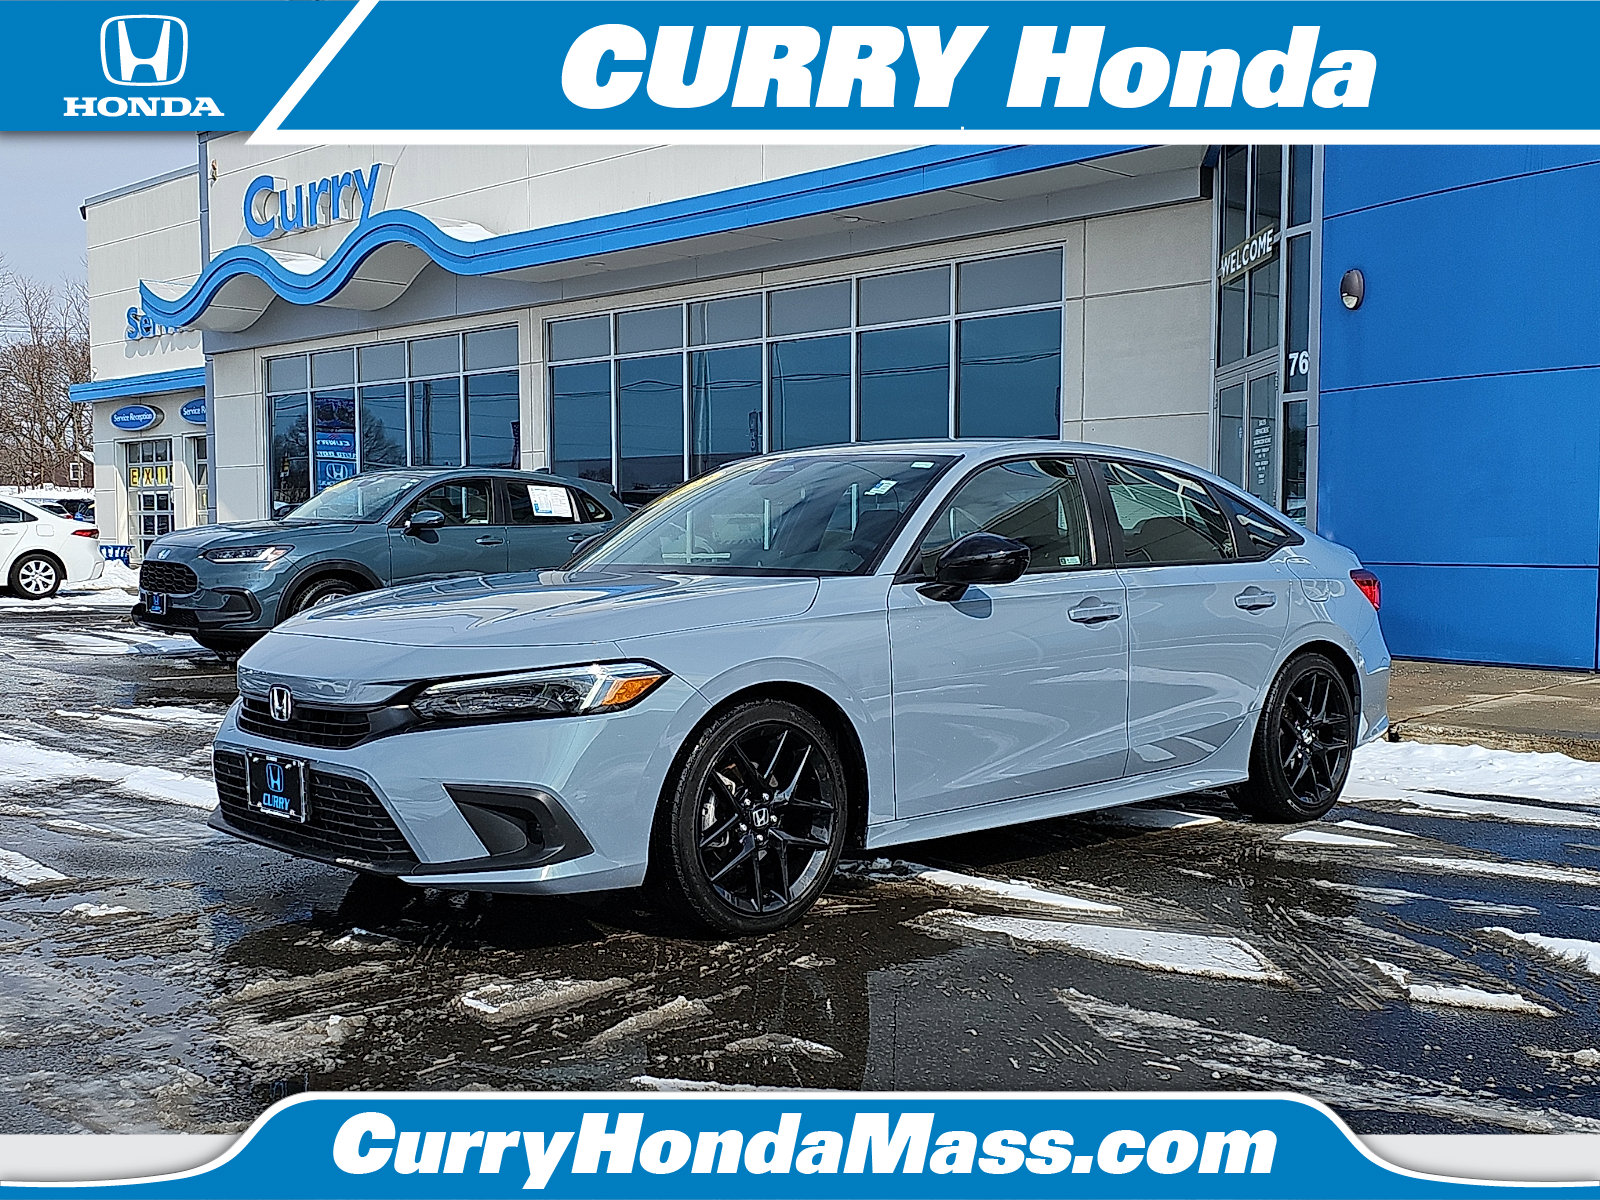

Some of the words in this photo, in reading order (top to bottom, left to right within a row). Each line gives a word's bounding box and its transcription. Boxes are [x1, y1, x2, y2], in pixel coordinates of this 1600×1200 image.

[243, 163, 381, 238] Curry
[1221, 229, 1274, 277] WELCOME
[1288, 351, 1310, 377] 76
[113, 413, 130, 423] Service
[129, 411, 153, 422] Reception
[131, 469, 167, 485] EXI
[263, 792, 291, 811] CURRY
